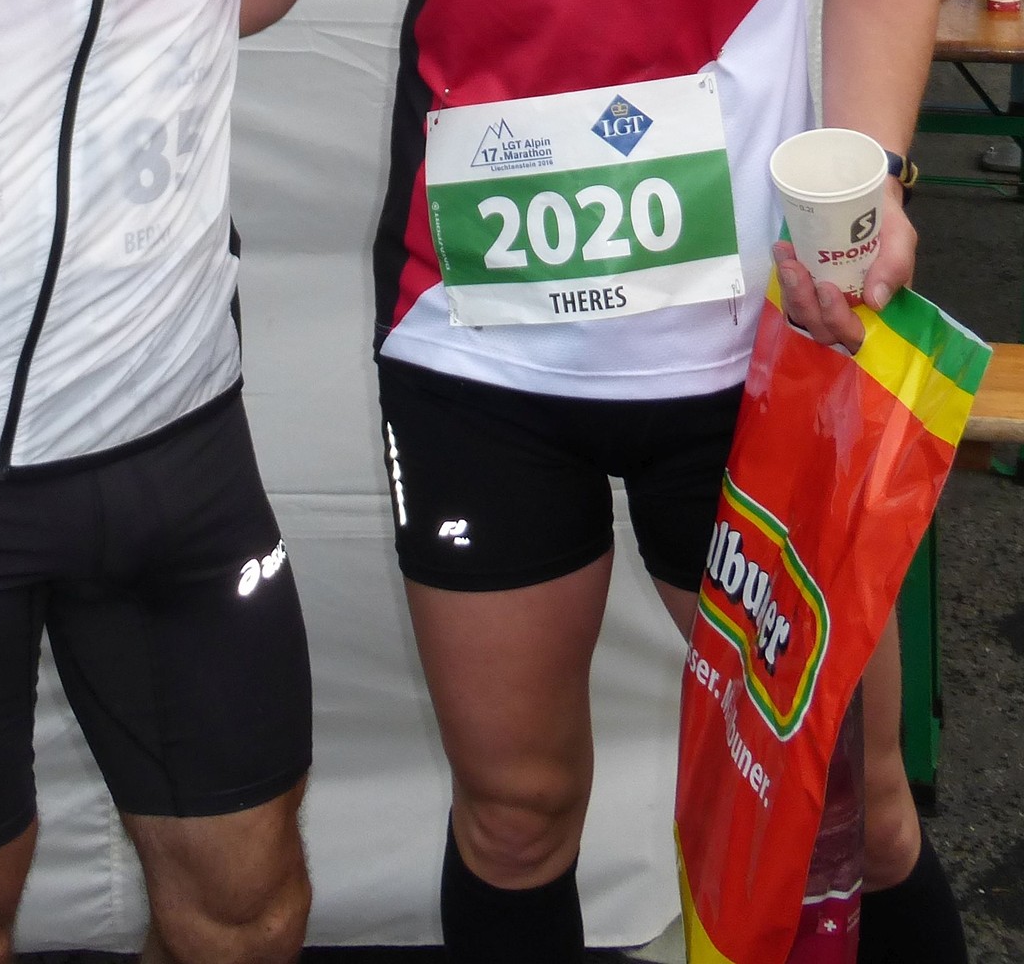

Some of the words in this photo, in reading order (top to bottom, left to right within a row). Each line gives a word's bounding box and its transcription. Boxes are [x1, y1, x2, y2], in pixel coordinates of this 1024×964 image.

[601, 115, 644, 138] LGT
[502, 139, 522, 151] LGT
[524, 137, 551, 149] Alpin
[503, 148, 552, 161] Marathon
[490, 162, 536, 172] Liechtenstein
[538, 159, 553, 168] 2016
[477, 177, 682, 269] 2020
[549, 285, 627, 314] THERES
